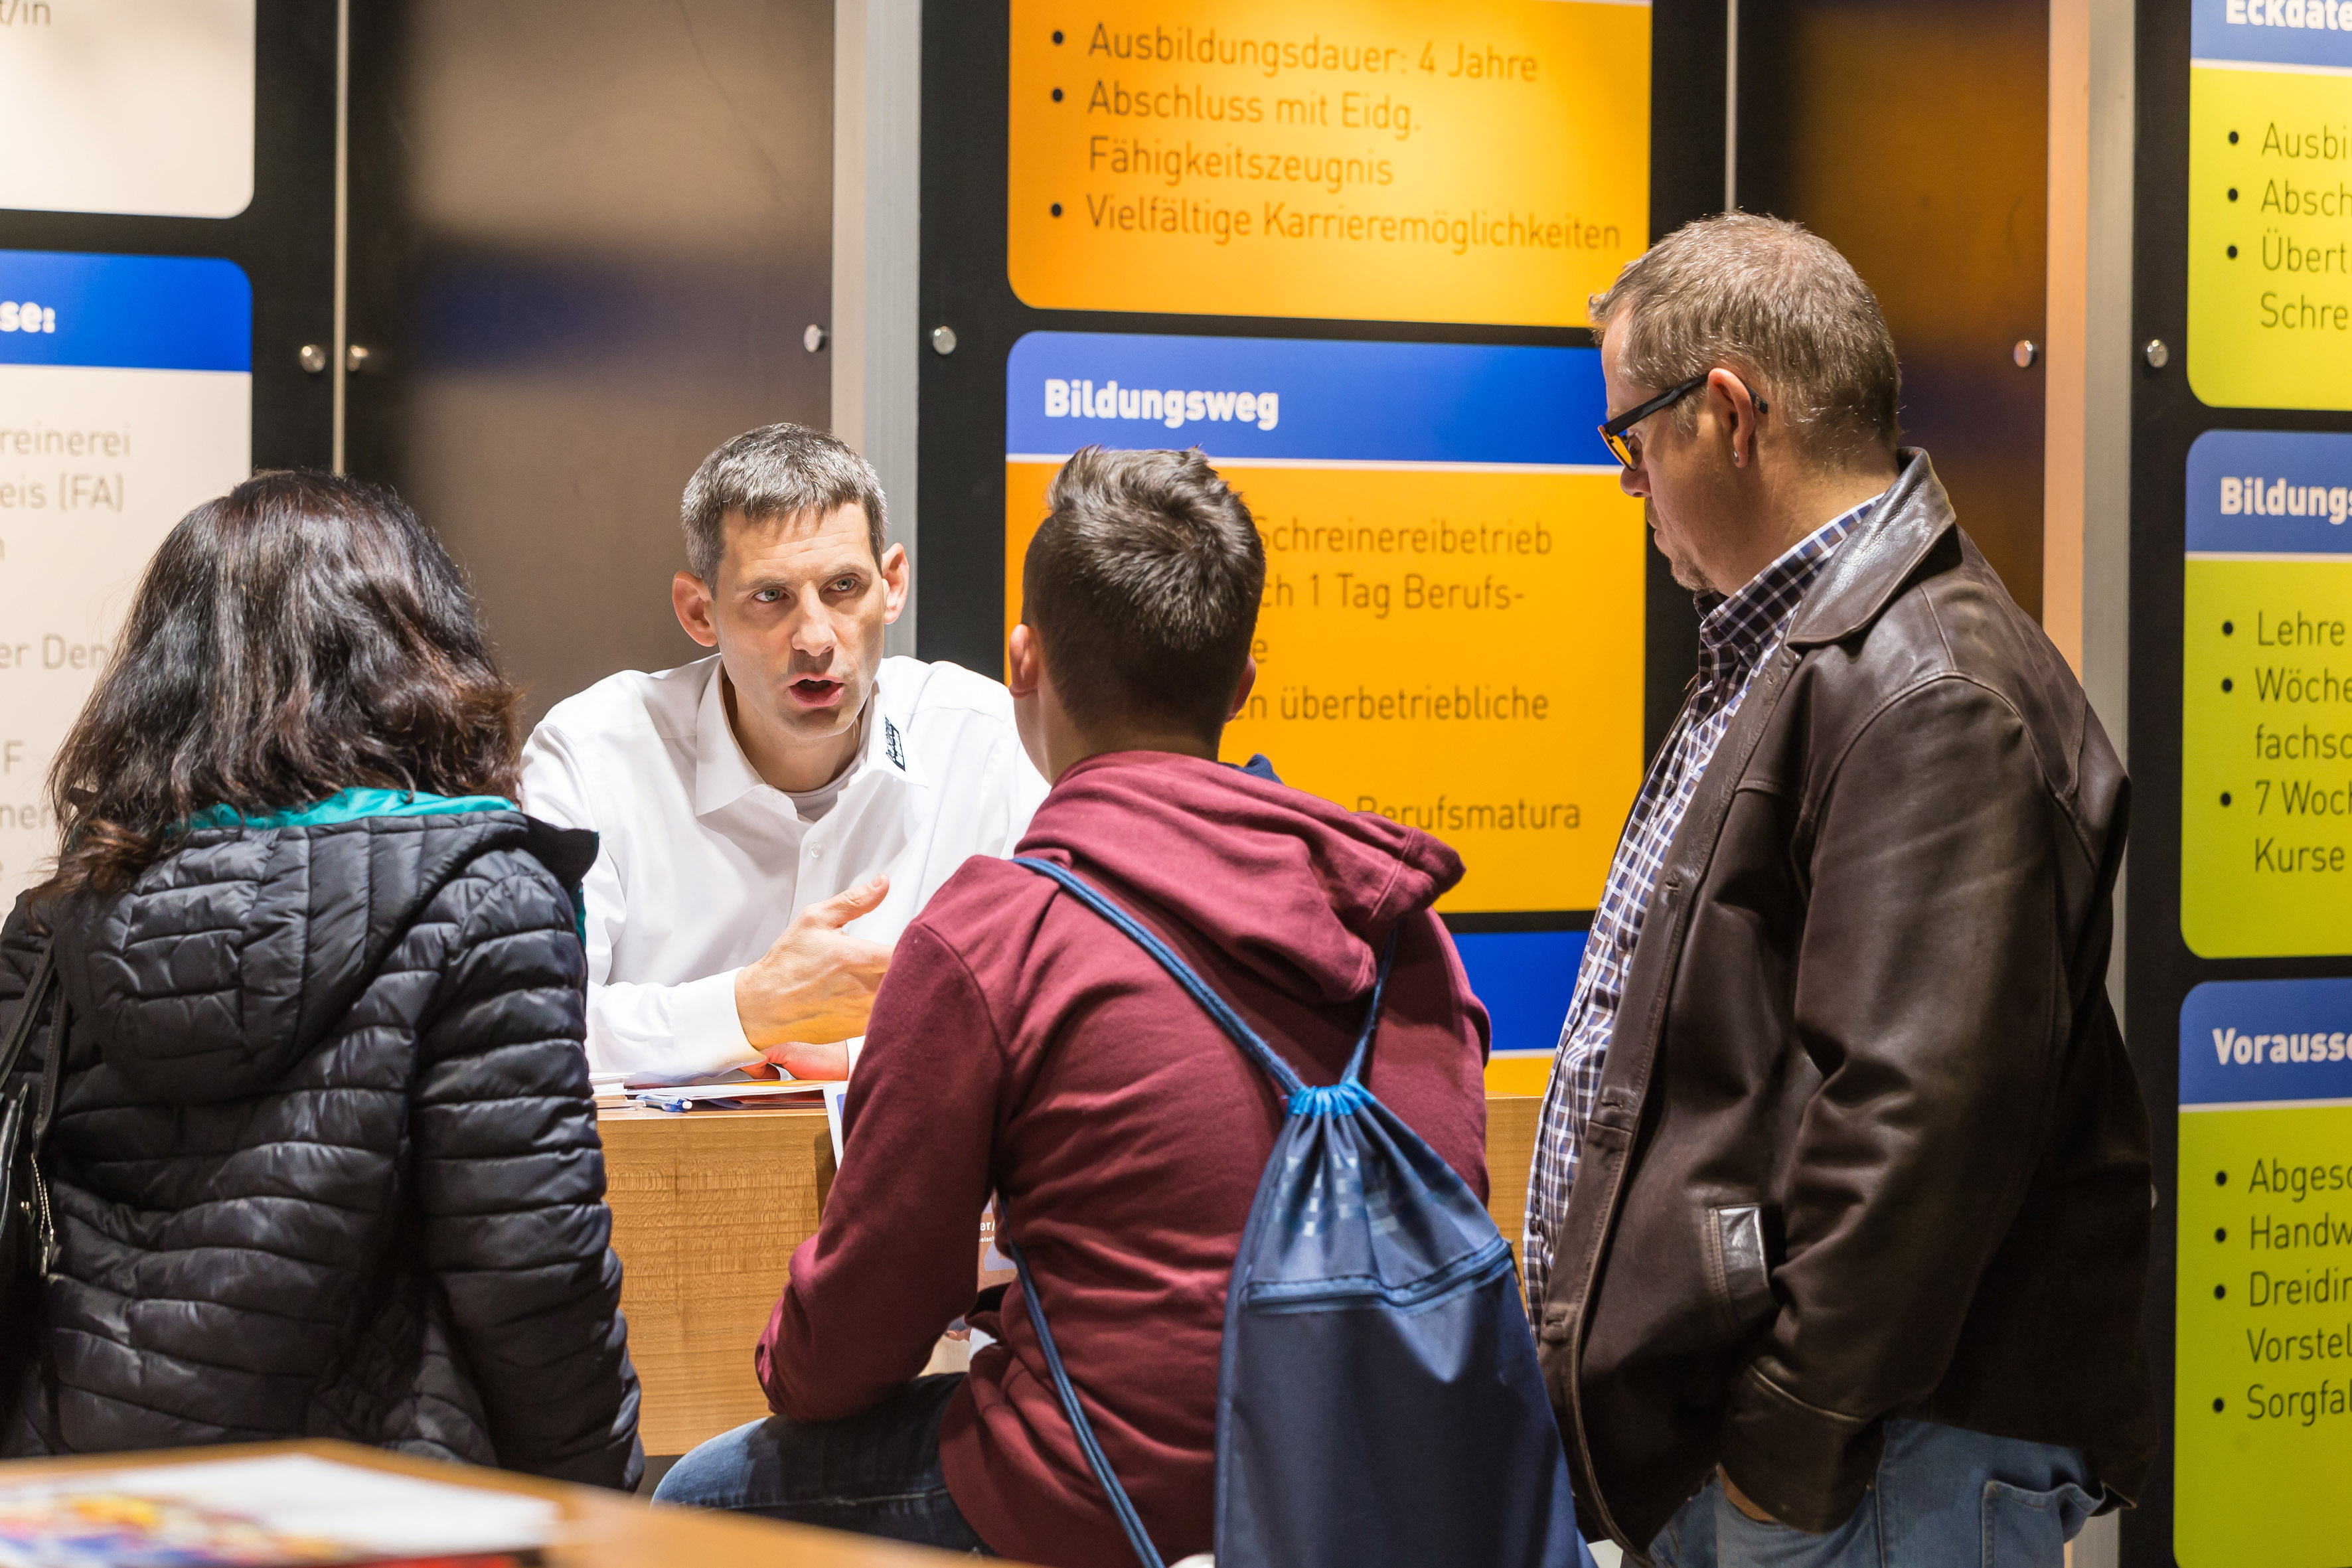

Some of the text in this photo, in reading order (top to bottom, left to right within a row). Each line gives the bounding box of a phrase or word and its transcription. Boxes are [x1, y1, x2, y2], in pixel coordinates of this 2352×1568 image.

[1088, 22, 1537, 82] Ausbildungsdauer: 4 Jahre
[1087, 78, 1421, 141] Abschluss mit Eidg.
[2261, 121, 2352, 160] Ausbi
[1089, 135, 1393, 193] Fähigkeitszeugnis
[2260, 179, 2352, 217] Absch
[1087, 193, 1620, 255] Vielfältige Karrieremöglichkeiten
[2260, 291, 2349, 331] Schre
[1045, 379, 1279, 431] Bildungsweg
[0, 418, 131, 457] reinerei
[1310, 573, 1320, 607] 1
[1336, 572, 1390, 619] Tag
[1404, 573, 1524, 611] Berufs-
[2258, 609, 2345, 647] Lehre
[1281, 685, 1549, 721] überbetriebliche
[2255, 779, 2352, 816] 7 Woc
[2256, 837, 2345, 874] Kurse
